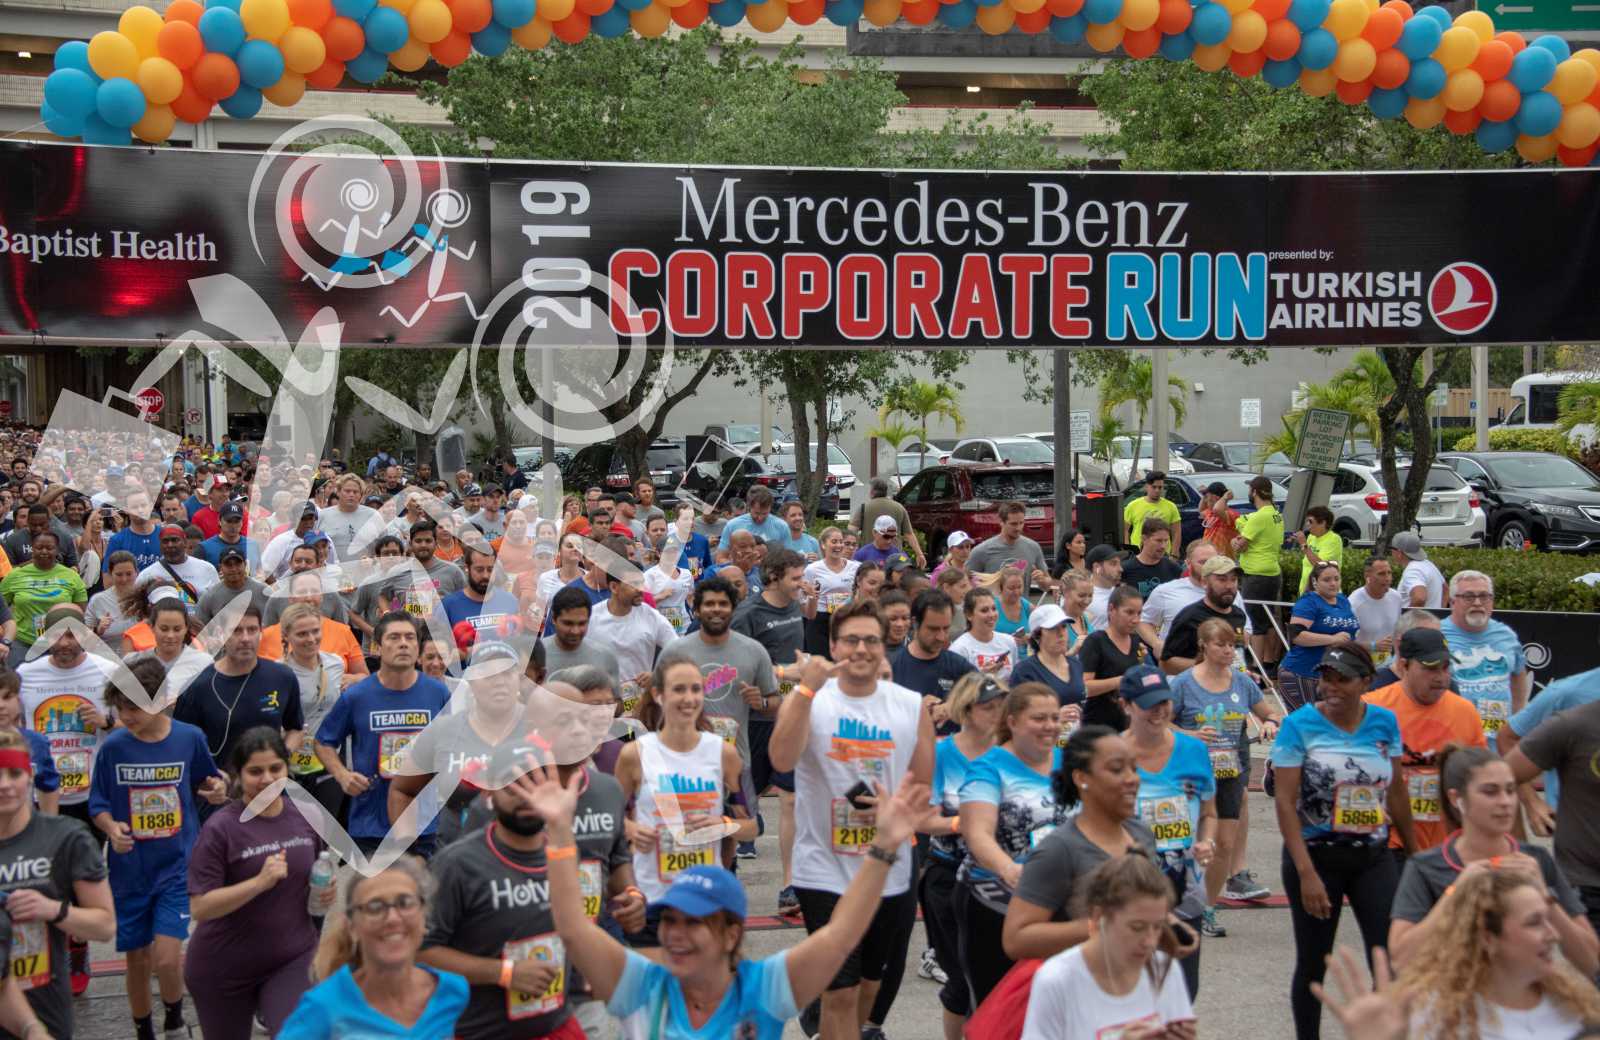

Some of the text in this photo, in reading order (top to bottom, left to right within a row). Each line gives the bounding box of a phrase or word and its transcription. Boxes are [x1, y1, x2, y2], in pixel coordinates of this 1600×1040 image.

[674, 176, 1190, 249] Mercedes-Benz
[0, 225, 218, 264] Baptist Health
[520, 180, 592, 330] 2019
[1268, 249, 1334, 262] presented by:
[608, 247, 1268, 341] CORPORATE RUN
[1270, 271, 1422, 299] TURKISH
[1269, 302, 1422, 329] AIRLINES
[138, 396, 162, 407] STOP
[374, 713, 428, 727] TEAMCGA
[121, 767, 181, 782] TEAMCGA
[138, 812, 176, 830] 1836
[571, 808, 614, 833] wire
[241, 841, 281, 859] akamai
[666, 851, 706, 872] 2091
[0, 856, 51, 881] wire
